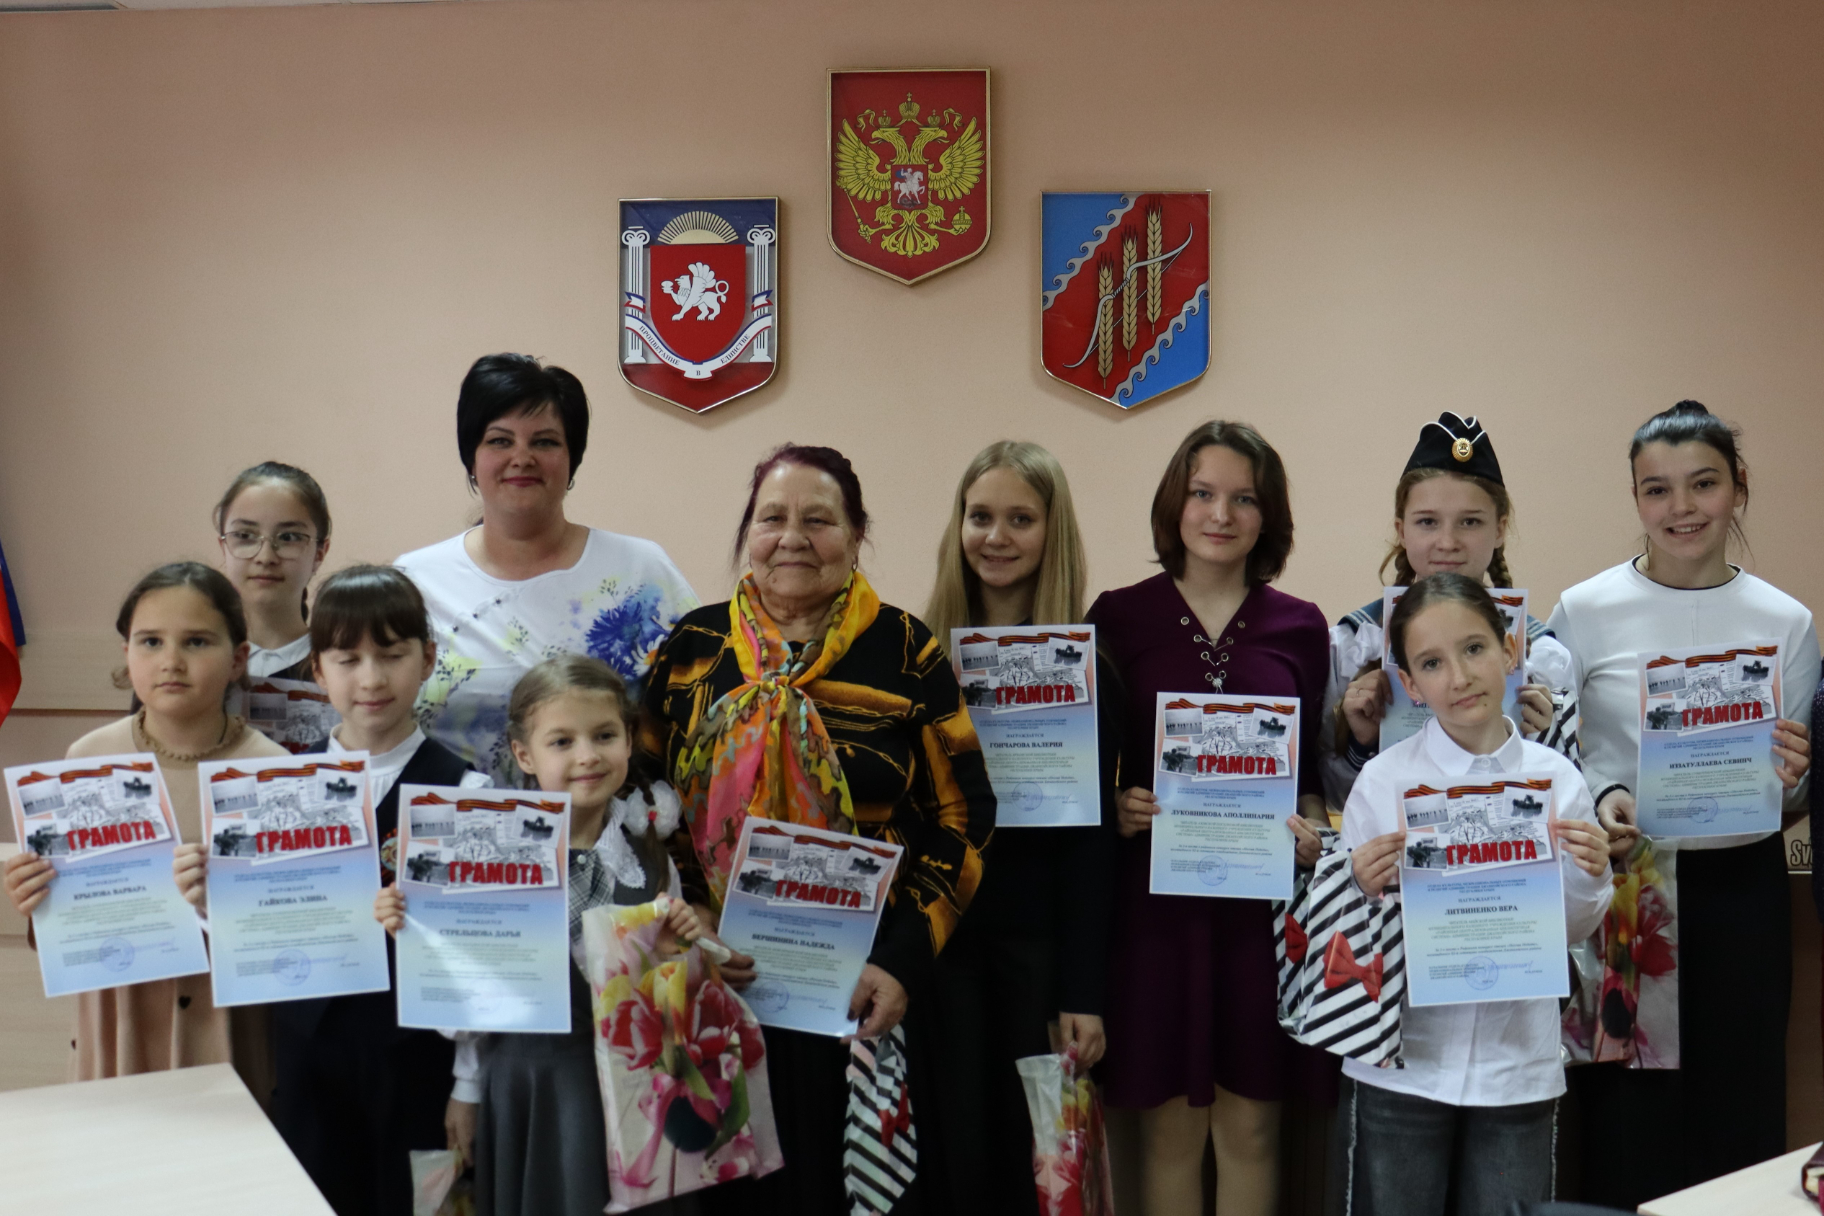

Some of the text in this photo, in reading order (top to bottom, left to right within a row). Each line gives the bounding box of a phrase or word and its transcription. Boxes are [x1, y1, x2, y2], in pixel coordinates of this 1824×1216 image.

[639, 325, 680, 366] ПРОЦВЕТАНИЕ
[720, 334, 751, 364] ЕДИНСТВЕ
[996, 684, 1076, 705] ГРАМОТА
[1682, 701, 1764, 727] ГРАМОТА
[1197, 754, 1277, 775] ГРАМОТА
[1222, 812, 1275, 820] АПОЛЛИНАРИЯ
[66, 820, 156, 851] ГРАМОТА
[256, 825, 353, 854] ГРАМОТА
[1446, 839, 1538, 866] ГРАМОТА
[1790, 839, 1813, 867] Sv
[449, 861, 543, 885] ГРАМОТА
[775, 879, 862, 908] ГРАМОТА
[1444, 904, 1519, 916] ЛИТВИНЕНКО ВЕРА
